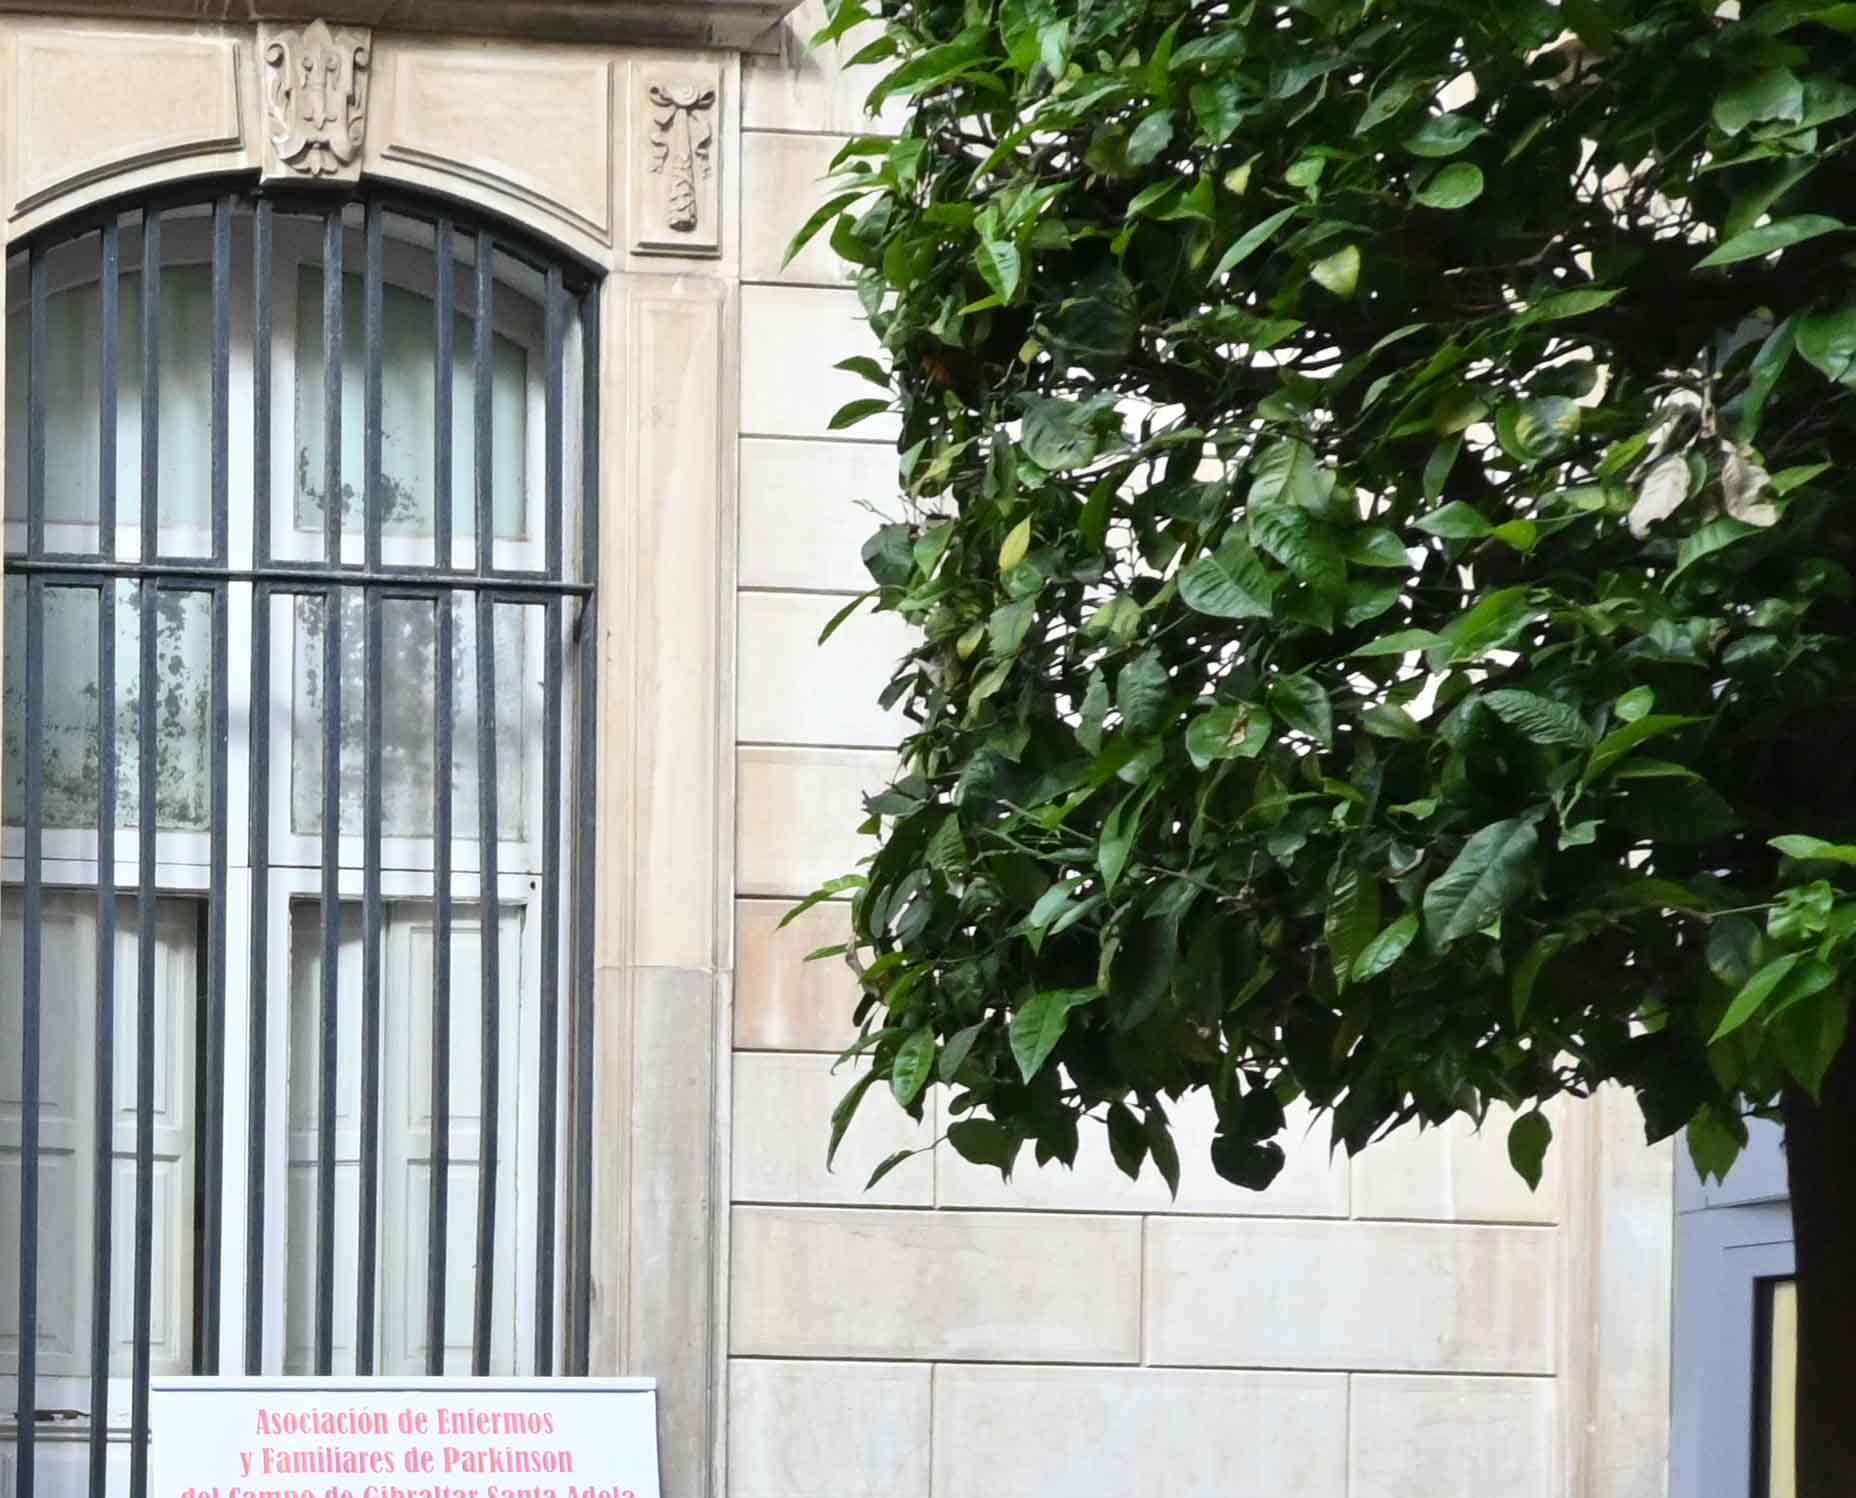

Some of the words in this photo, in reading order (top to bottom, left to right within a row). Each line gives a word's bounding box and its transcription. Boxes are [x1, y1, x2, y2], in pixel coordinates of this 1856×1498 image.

[256, 1405, 389, 1435] Asociación
[398, 1408, 428, 1434] de
[437, 1408, 554, 1435] Enfermos
[240, 1450, 252, 1478] y
[262, 1446, 395, 1474] Familiares
[405, 1446, 434, 1474] de
[443, 1446, 574, 1473] Parkinson
